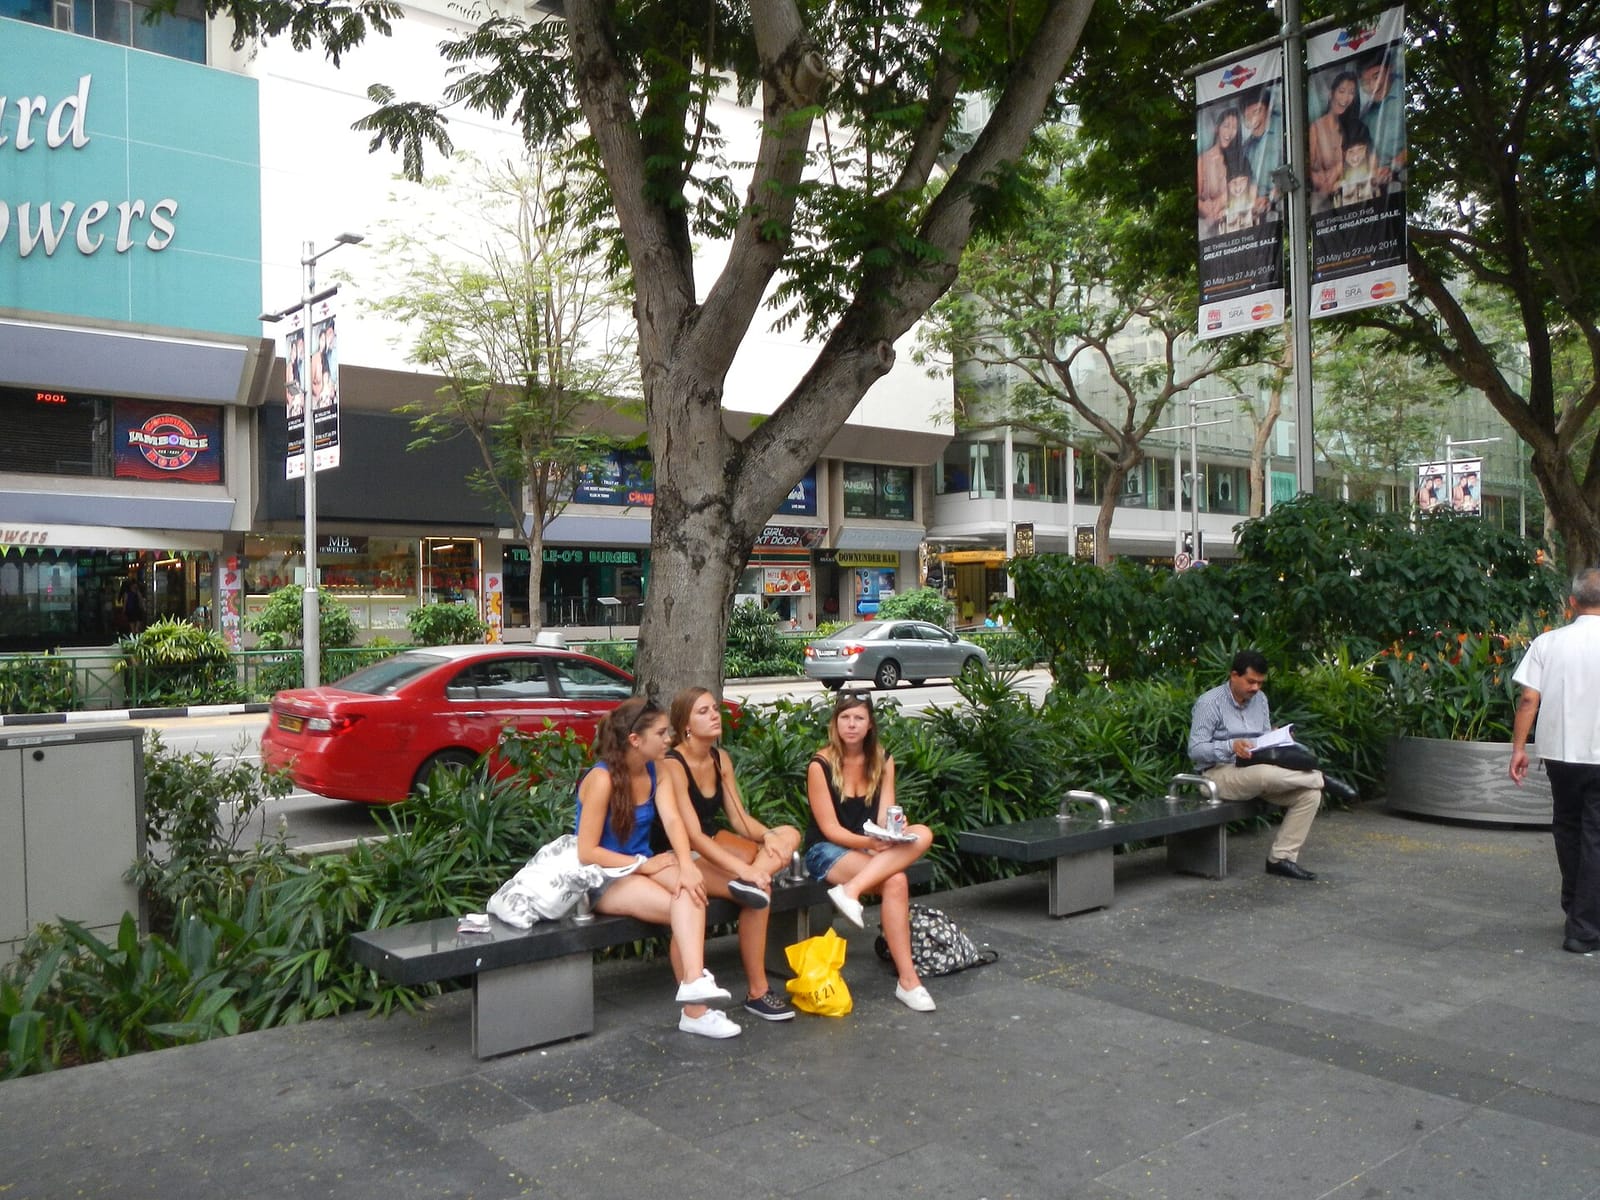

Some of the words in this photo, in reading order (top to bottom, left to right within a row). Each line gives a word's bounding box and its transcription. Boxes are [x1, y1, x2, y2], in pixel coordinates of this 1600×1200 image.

[0, 73, 92, 151] rd
[1316, 225, 1338, 236] GREAT
[1338, 214, 1379, 230] SINGAPORE
[1203, 250, 1222, 261] GREAT
[1223, 241, 1259, 256] SINGAPORE
[1316, 256, 1325, 265] 30
[1326, 254, 1341, 264] May
[1342, 251, 1351, 259] to
[1352, 247, 1361, 256] 27
[1362, 244, 1378, 254] July
[1378, 239, 1398, 250] 2014
[1235, 272, 1243, 280] 27
[1244, 268, 1257, 278] July
[1257, 264, 1275, 275] 2014
[37, 393, 66, 403] POOL
[128, 431, 208, 448] JAMBOREE
[755, 536, 769, 544] XT
[770, 536, 799, 545] DOOR
[763, 528, 784, 537] GIRL
[328, 536, 350, 547] MB
[512, 549, 583, 562] TRLE-O'S
[589, 551, 638, 563] BURGER
[839, 551, 881, 563] DOWNUNDER
[882, 553, 897, 563] BAR
[822, 983, 836, 999] 21
